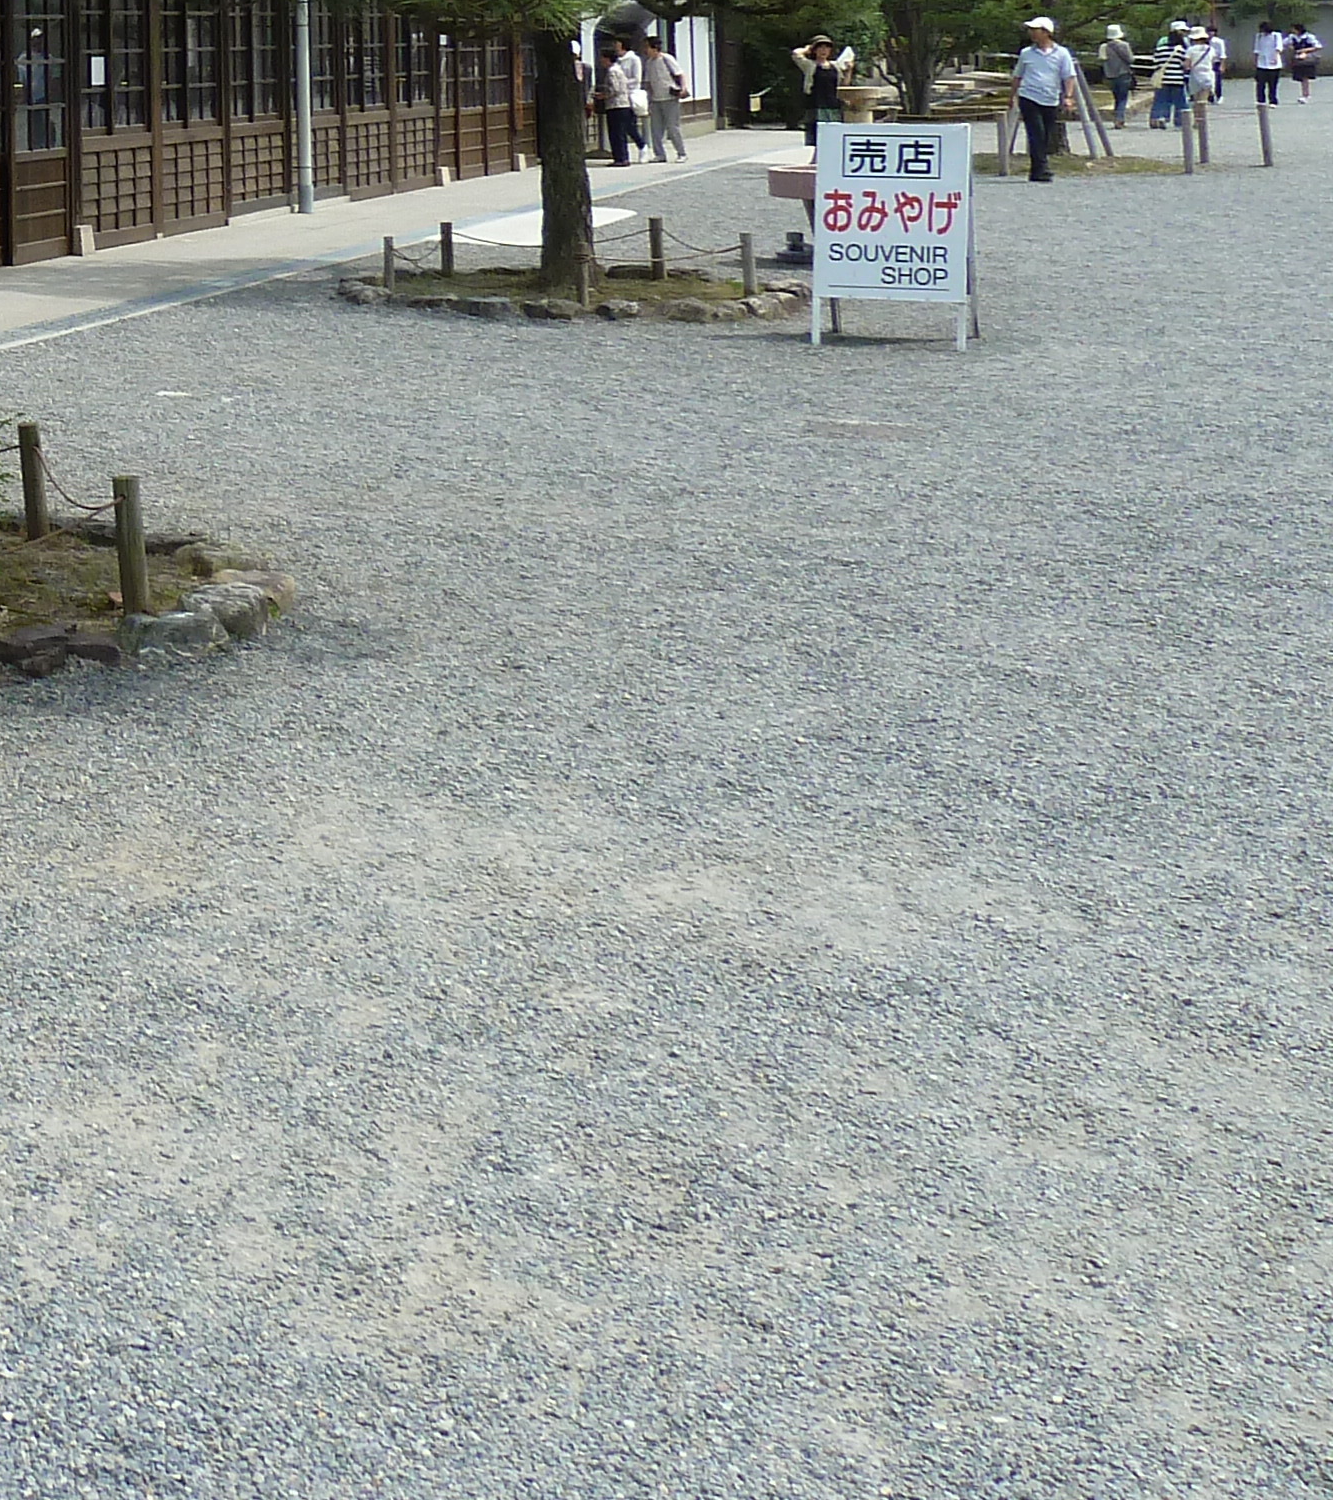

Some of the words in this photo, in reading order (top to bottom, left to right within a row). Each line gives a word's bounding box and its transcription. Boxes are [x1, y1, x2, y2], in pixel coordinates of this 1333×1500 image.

[849, 139, 935, 175] 売店
[823, 188, 962, 235] おみやげ
[828, 243, 948, 264] SOUVENIR
[881, 266, 949, 285] SHOP
